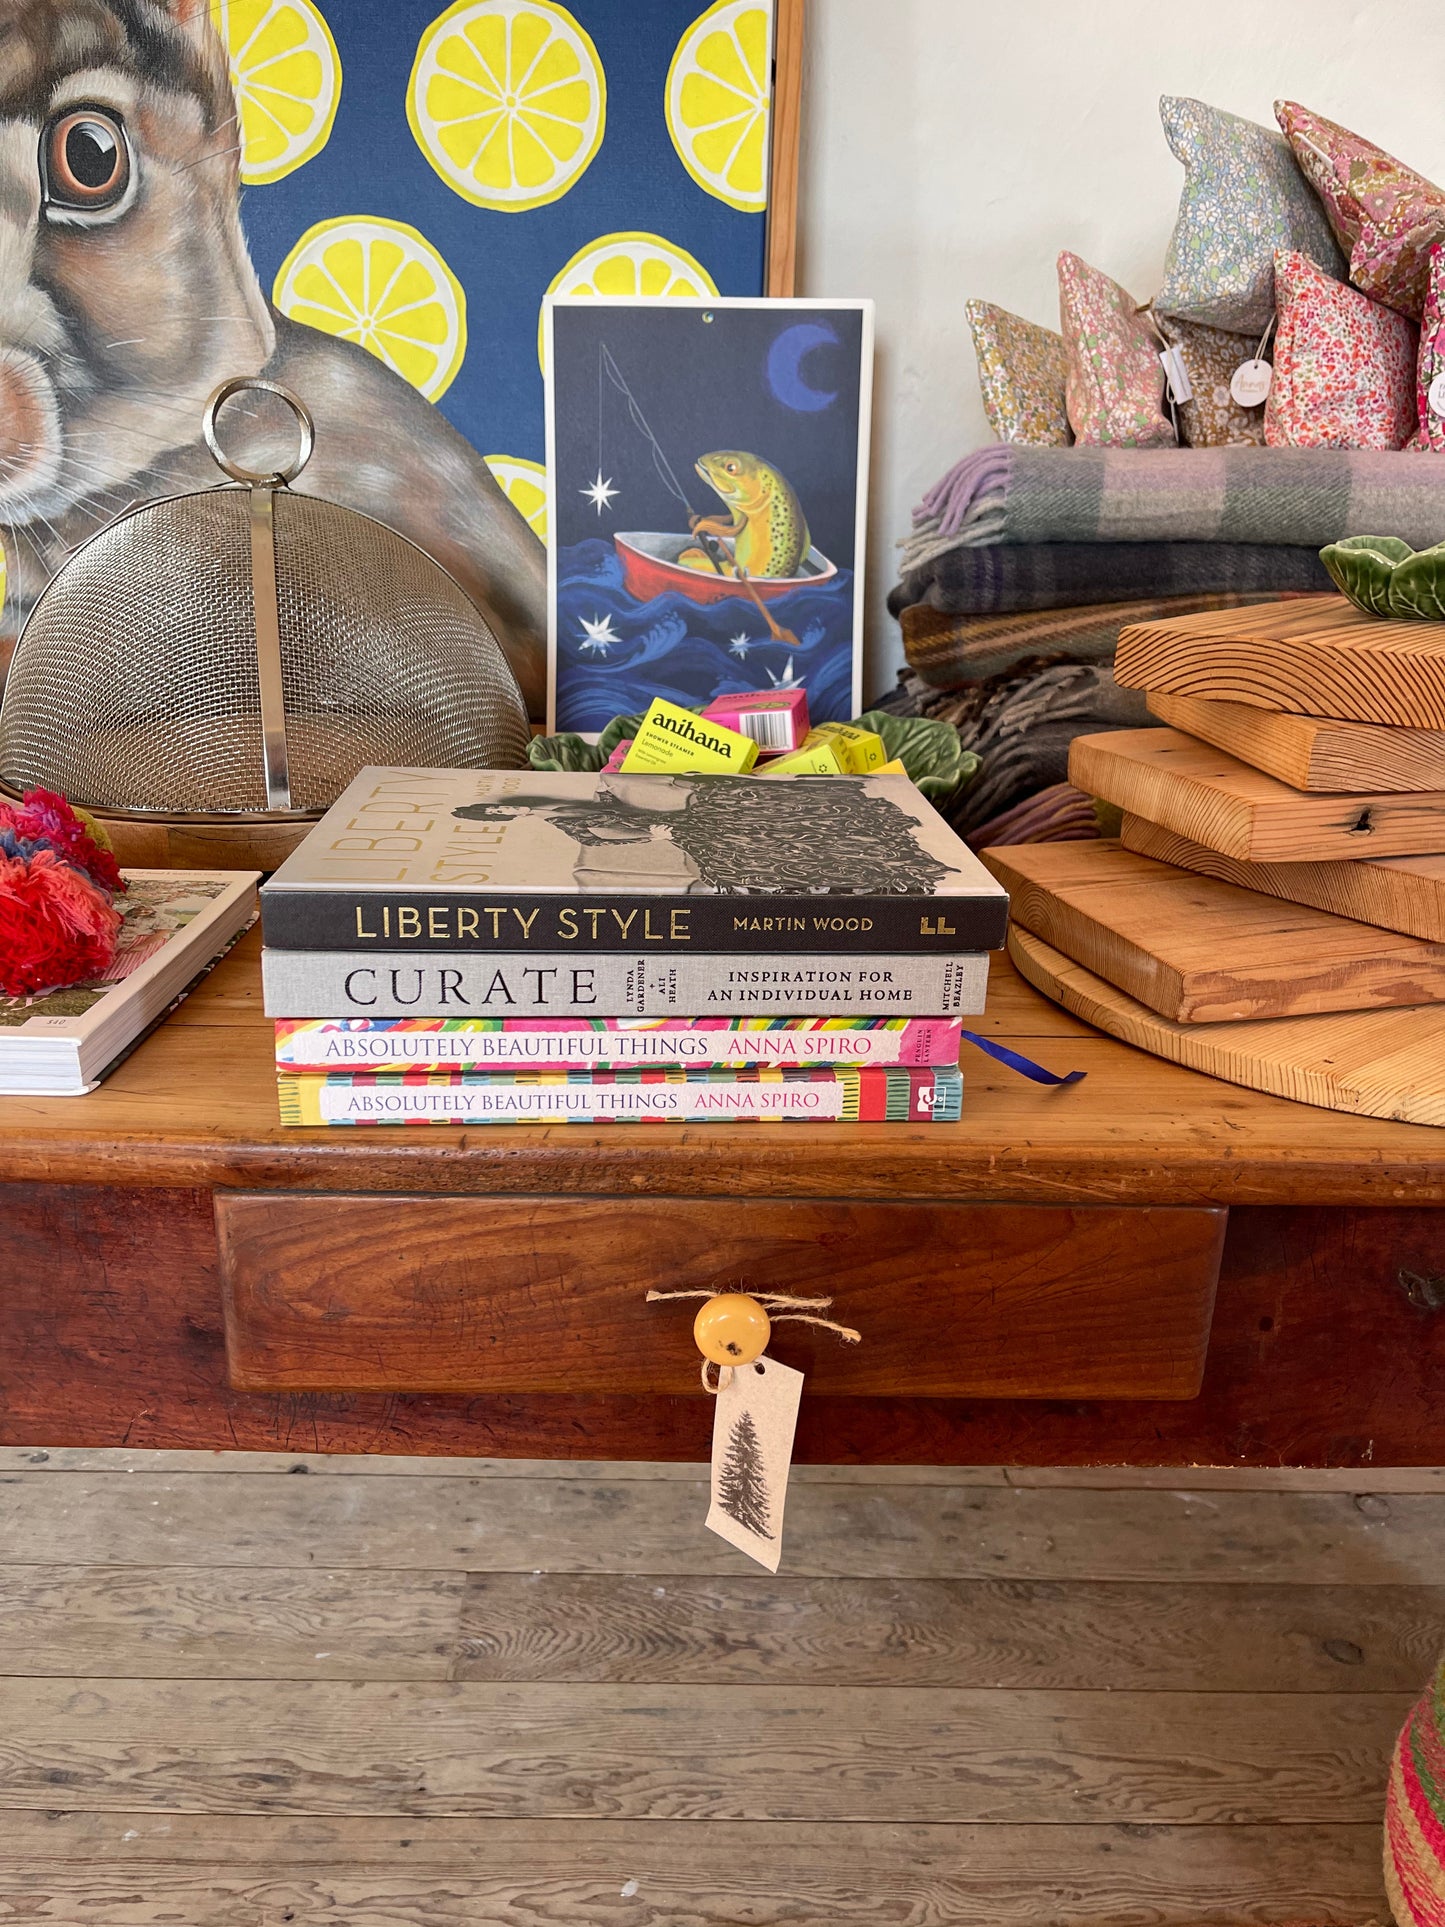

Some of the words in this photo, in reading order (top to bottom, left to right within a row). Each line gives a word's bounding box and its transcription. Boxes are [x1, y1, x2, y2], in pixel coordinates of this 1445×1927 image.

[641, 739, 674, 758] Lemonade
[646, 732, 669, 746] SHOWER
[670, 742, 695, 757] STEAMER
[652, 713, 732, 758] anihana
[306, 770, 457, 881] LIBERTY
[430, 825, 507, 884] STYLE
[355, 905, 540, 940] LIBERTY
[557, 906, 692, 941] STYLE
[732, 917, 806, 932] MARTIN
[813, 917, 874, 932] WOOD
[344, 967, 598, 1006] CURATE
[626, 969, 635, 1003] LYNDA
[636, 959, 645, 1013] GARDENER
[658, 977, 666, 995] ALI
[668, 968, 677, 1004] HEATH
[728, 970, 856, 984] INSPIRATION
[858, 970, 894, 983] FOR
[942, 961, 954, 1011] MITCHELL
[953, 965, 964, 1008] BEAZLEY
[707, 988, 736, 1002] AN
[738, 988, 853, 1002] INDIVIDUAL
[859, 988, 914, 1001] HOME
[325, 1037, 474, 1058] ABSOLUTELY
[482, 1037, 609, 1057] BEAUTIFUL
[614, 1037, 709, 1056] THINGS
[727, 1037, 797, 1056] ANNA
[804, 1036, 872, 1056] SPIRO
[347, 1094, 476, 1112] ABSOLUTELY
[482, 1094, 592, 1111] BEAUTIFUL
[596, 1093, 678, 1109] THINGS
[694, 1093, 756, 1109] ANNA
[761, 1092, 820, 1108] SPIRO
